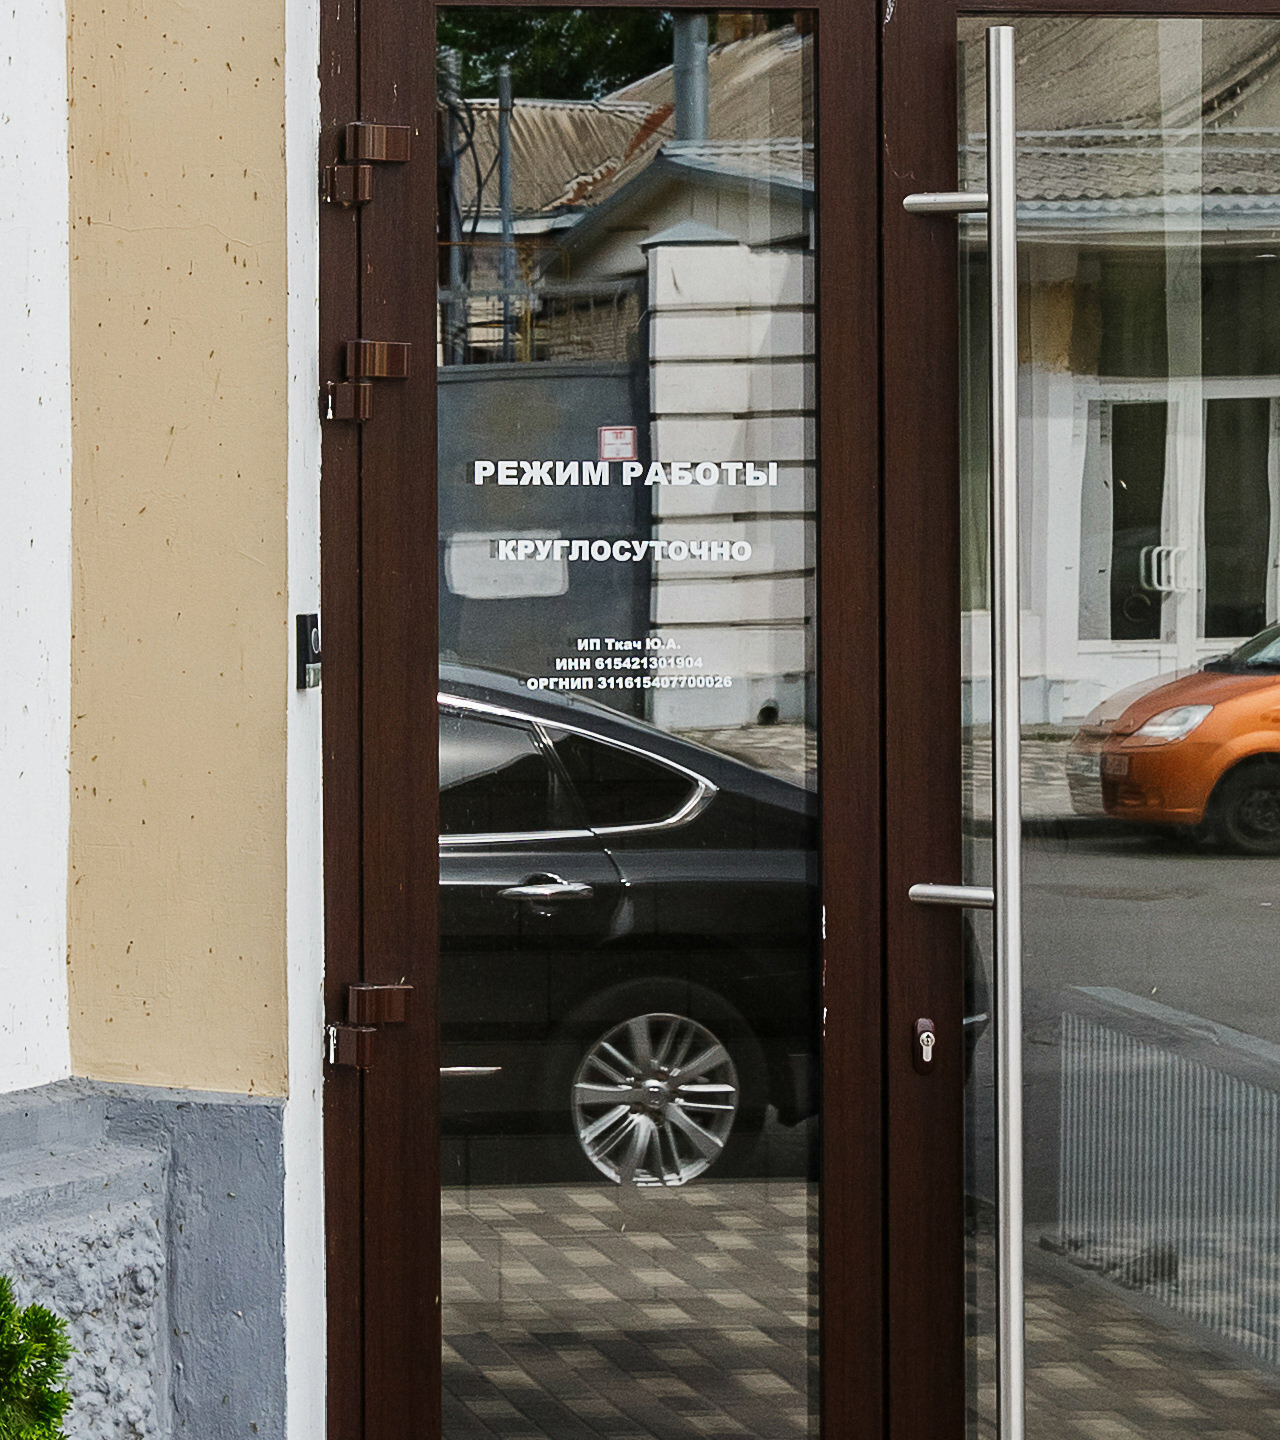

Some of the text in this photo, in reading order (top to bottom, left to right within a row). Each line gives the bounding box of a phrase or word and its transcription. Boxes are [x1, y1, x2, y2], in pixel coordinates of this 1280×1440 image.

[474, 460, 778, 487] РЕЖИМ РАБОТЫ
[497, 539, 753, 562] КРУГЛОСУТОЧНО
[577, 638, 681, 651] ИП Ткач Ю.А.
[555, 658, 591, 671] ИНН
